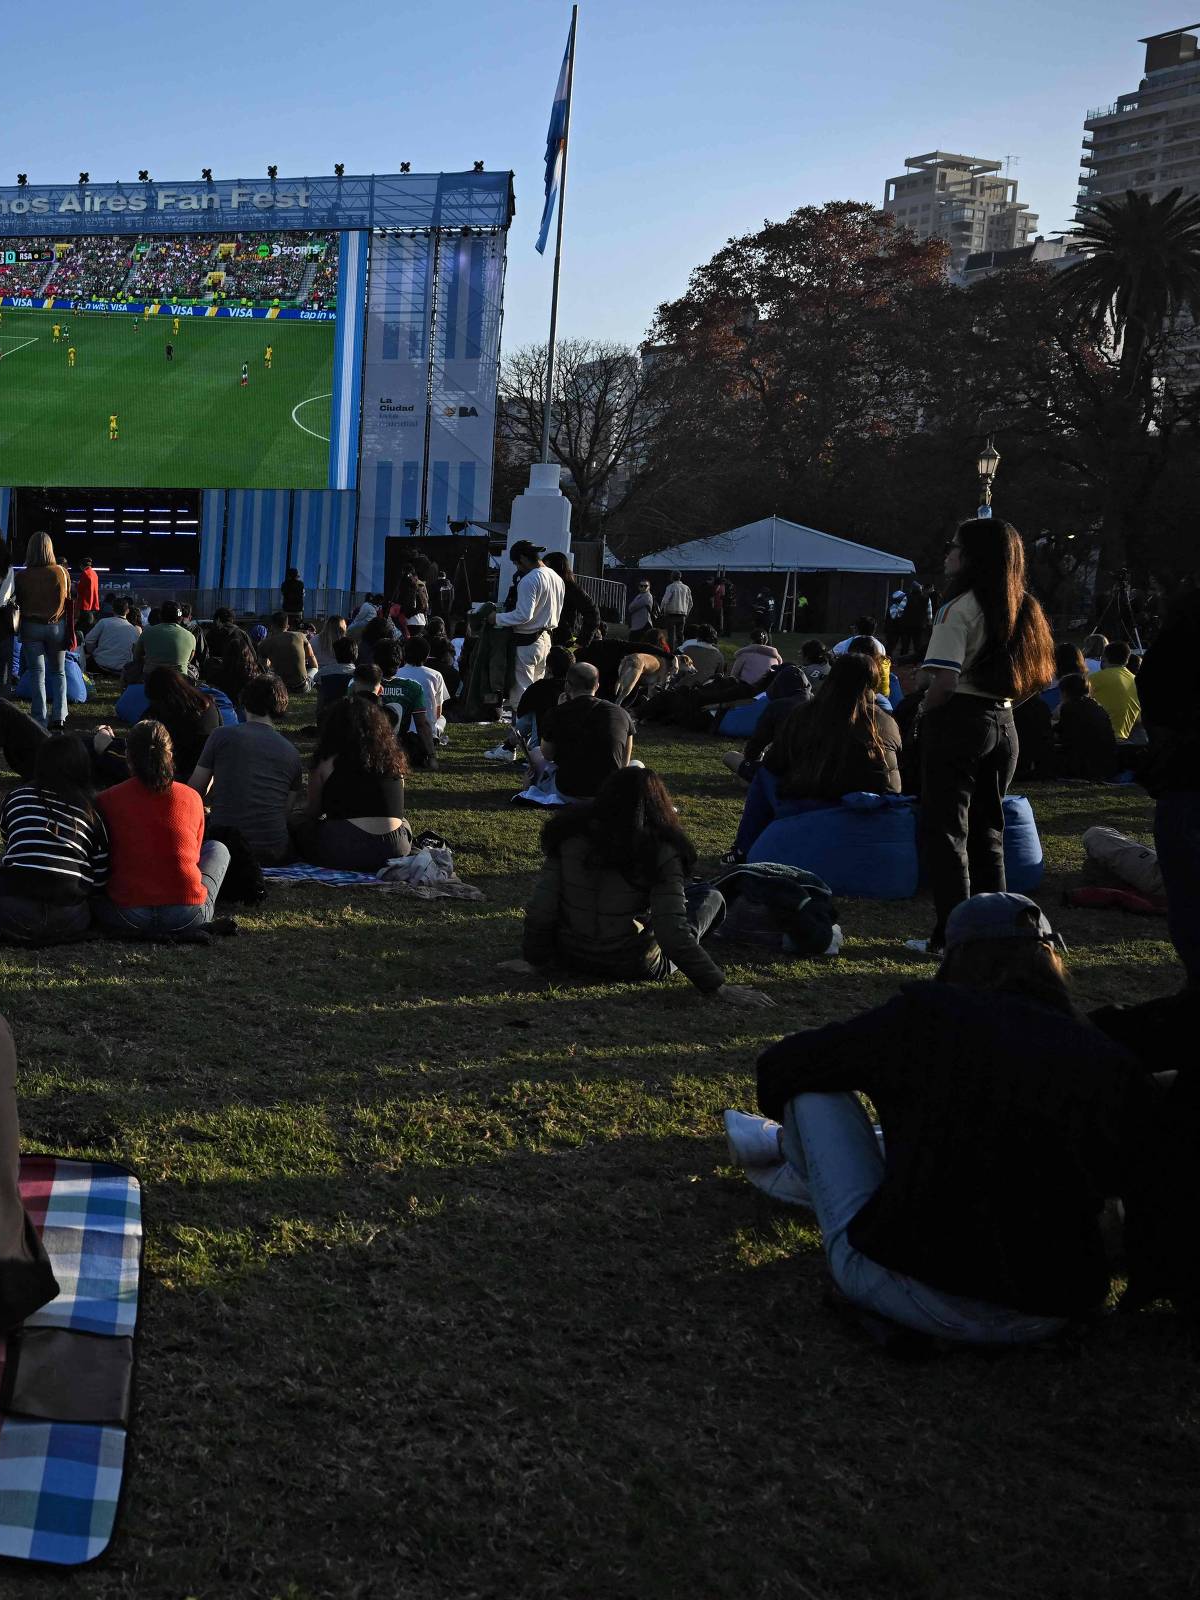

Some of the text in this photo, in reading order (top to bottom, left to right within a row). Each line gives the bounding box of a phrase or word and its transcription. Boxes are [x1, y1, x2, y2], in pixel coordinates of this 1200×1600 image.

[58, 191, 147, 215] Aires
[156, 189, 221, 211] Fan
[230, 186, 310, 210] Fest
[11, 297, 33, 307] VISA
[111, 304, 127, 312] VISA
[170, 305, 193, 316] VISA
[228, 308, 253, 317] VISA
[300, 310, 317, 320] tap
[318, 310, 326, 319] in
[380, 404, 414, 412] Ciudad
[458, 406, 478, 417] BA
